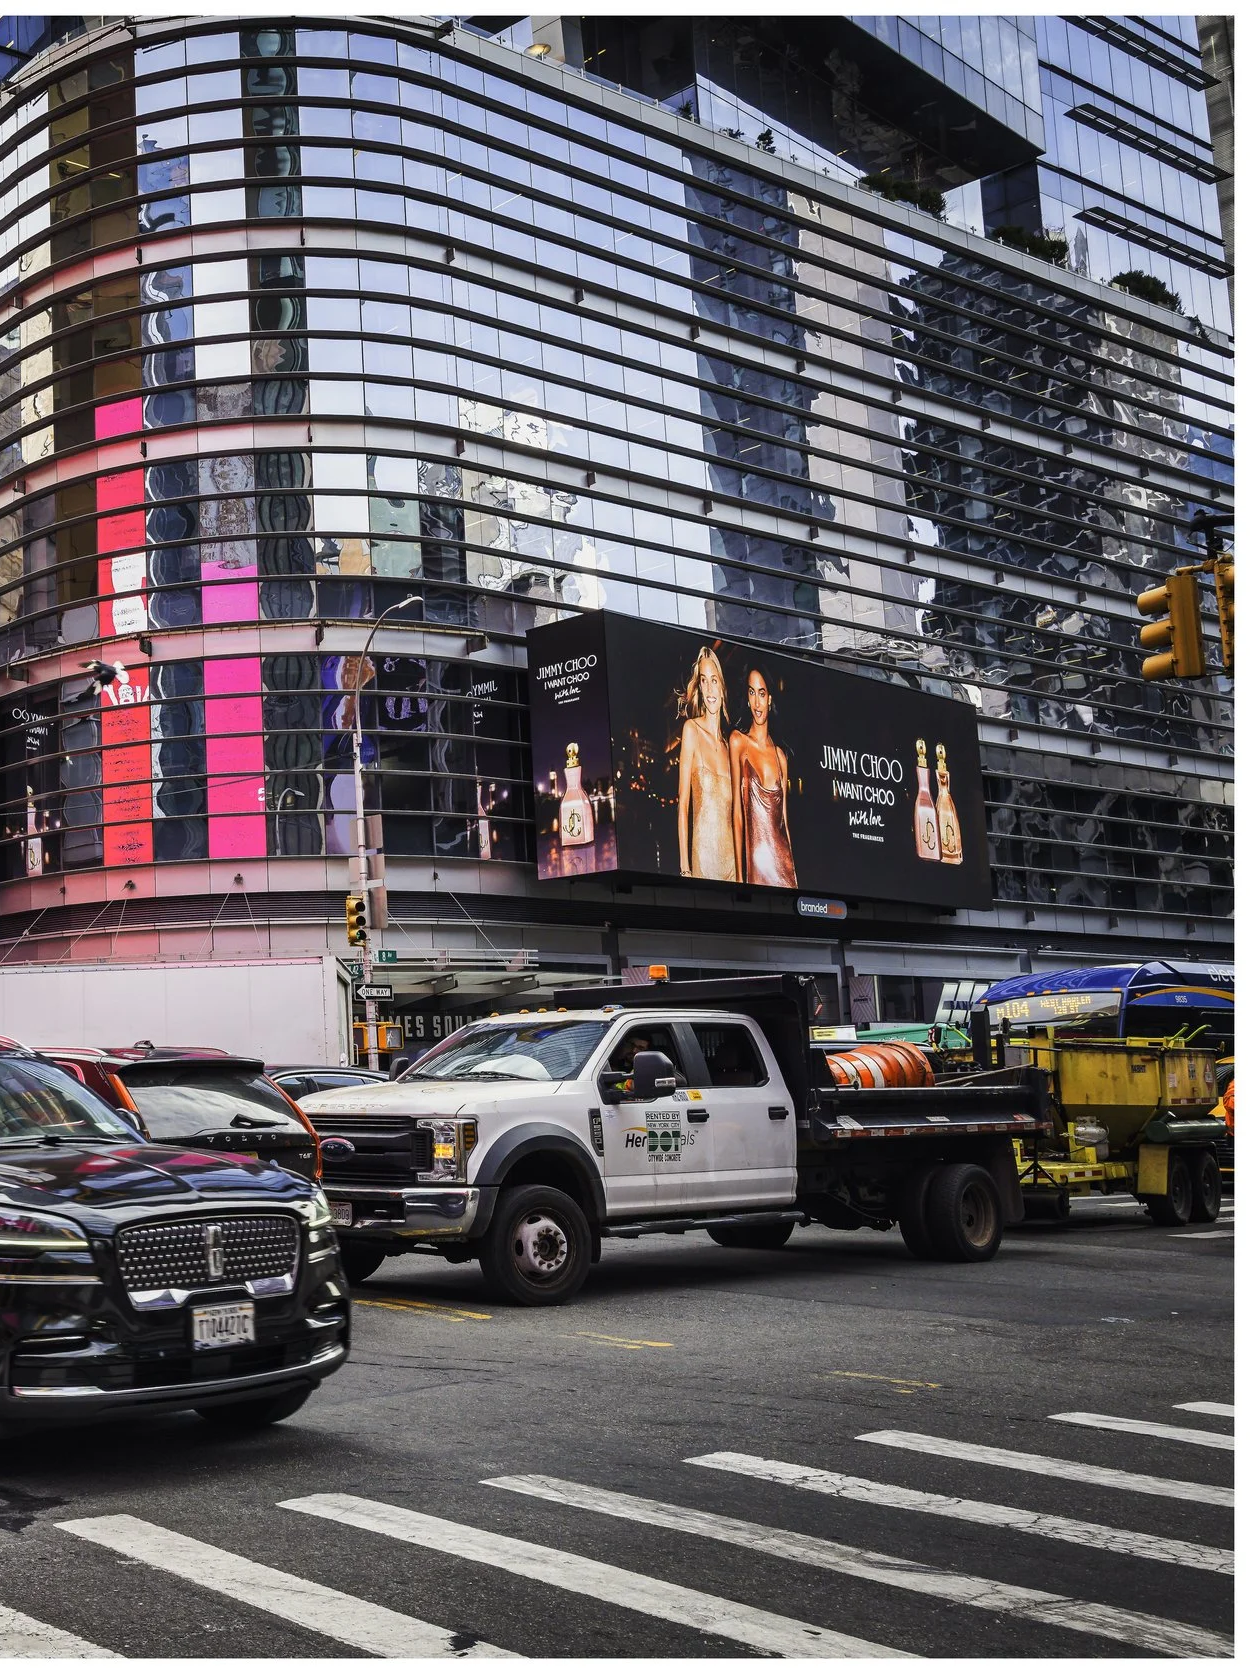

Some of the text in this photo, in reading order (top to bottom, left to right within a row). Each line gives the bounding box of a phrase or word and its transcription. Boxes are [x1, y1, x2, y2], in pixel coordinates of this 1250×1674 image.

[537, 654, 598, 680] JIMMY CHOO
[547, 676, 566, 689] WANT
[566, 671, 590, 685] CHOO
[820, 744, 903, 783] JIMMY CHOO
[832, 779, 895, 806] I WANT CHOO
[361, 988, 388, 996] ONE WAY
[206, 1133, 277, 1143] VOLVO
[648, 1131, 681, 1152] DOT
